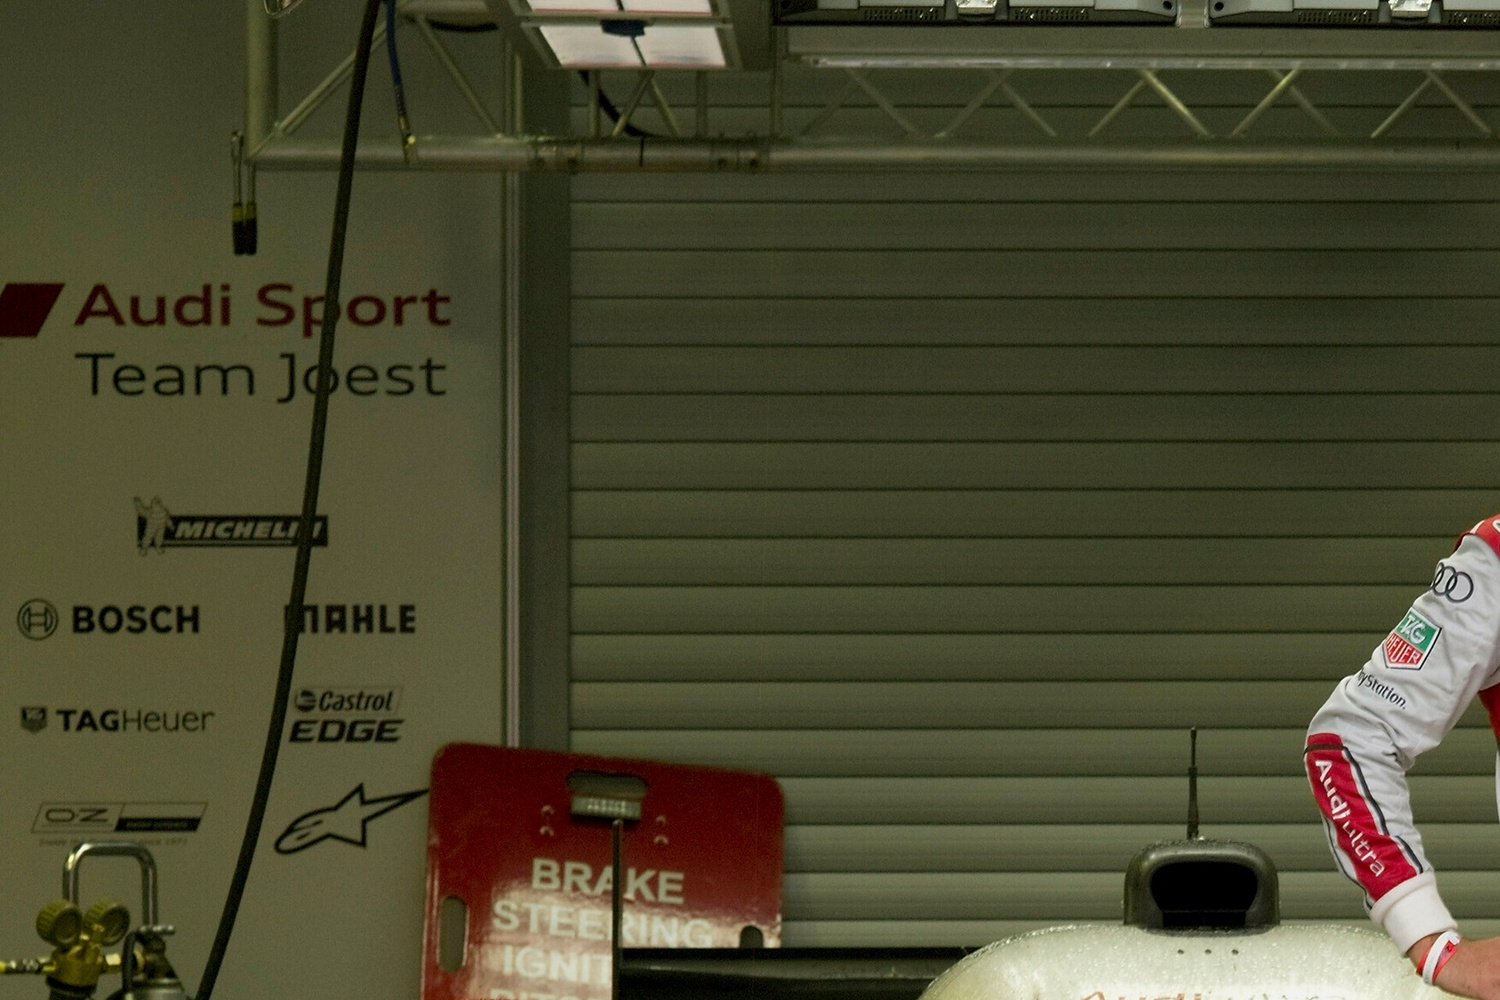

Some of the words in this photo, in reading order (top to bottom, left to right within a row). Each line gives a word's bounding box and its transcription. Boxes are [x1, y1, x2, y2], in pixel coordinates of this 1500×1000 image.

[74, 283, 231, 327] Audi
[256, 283, 453, 338] Sport
[74, 352, 256, 396] Team
[277, 352, 447, 403] Joest
[72, 605, 200, 633] BOSCH
[319, 690, 393, 712] Castrol
[288, 718, 405, 743] EDGE
[1315, 760, 1350, 820] Audi
[1342, 820, 1386, 877] ultra
[531, 857, 685, 905] BRAKE
[492, 899, 713, 949] STEERING
[501, 944, 612, 985] IGNIT
